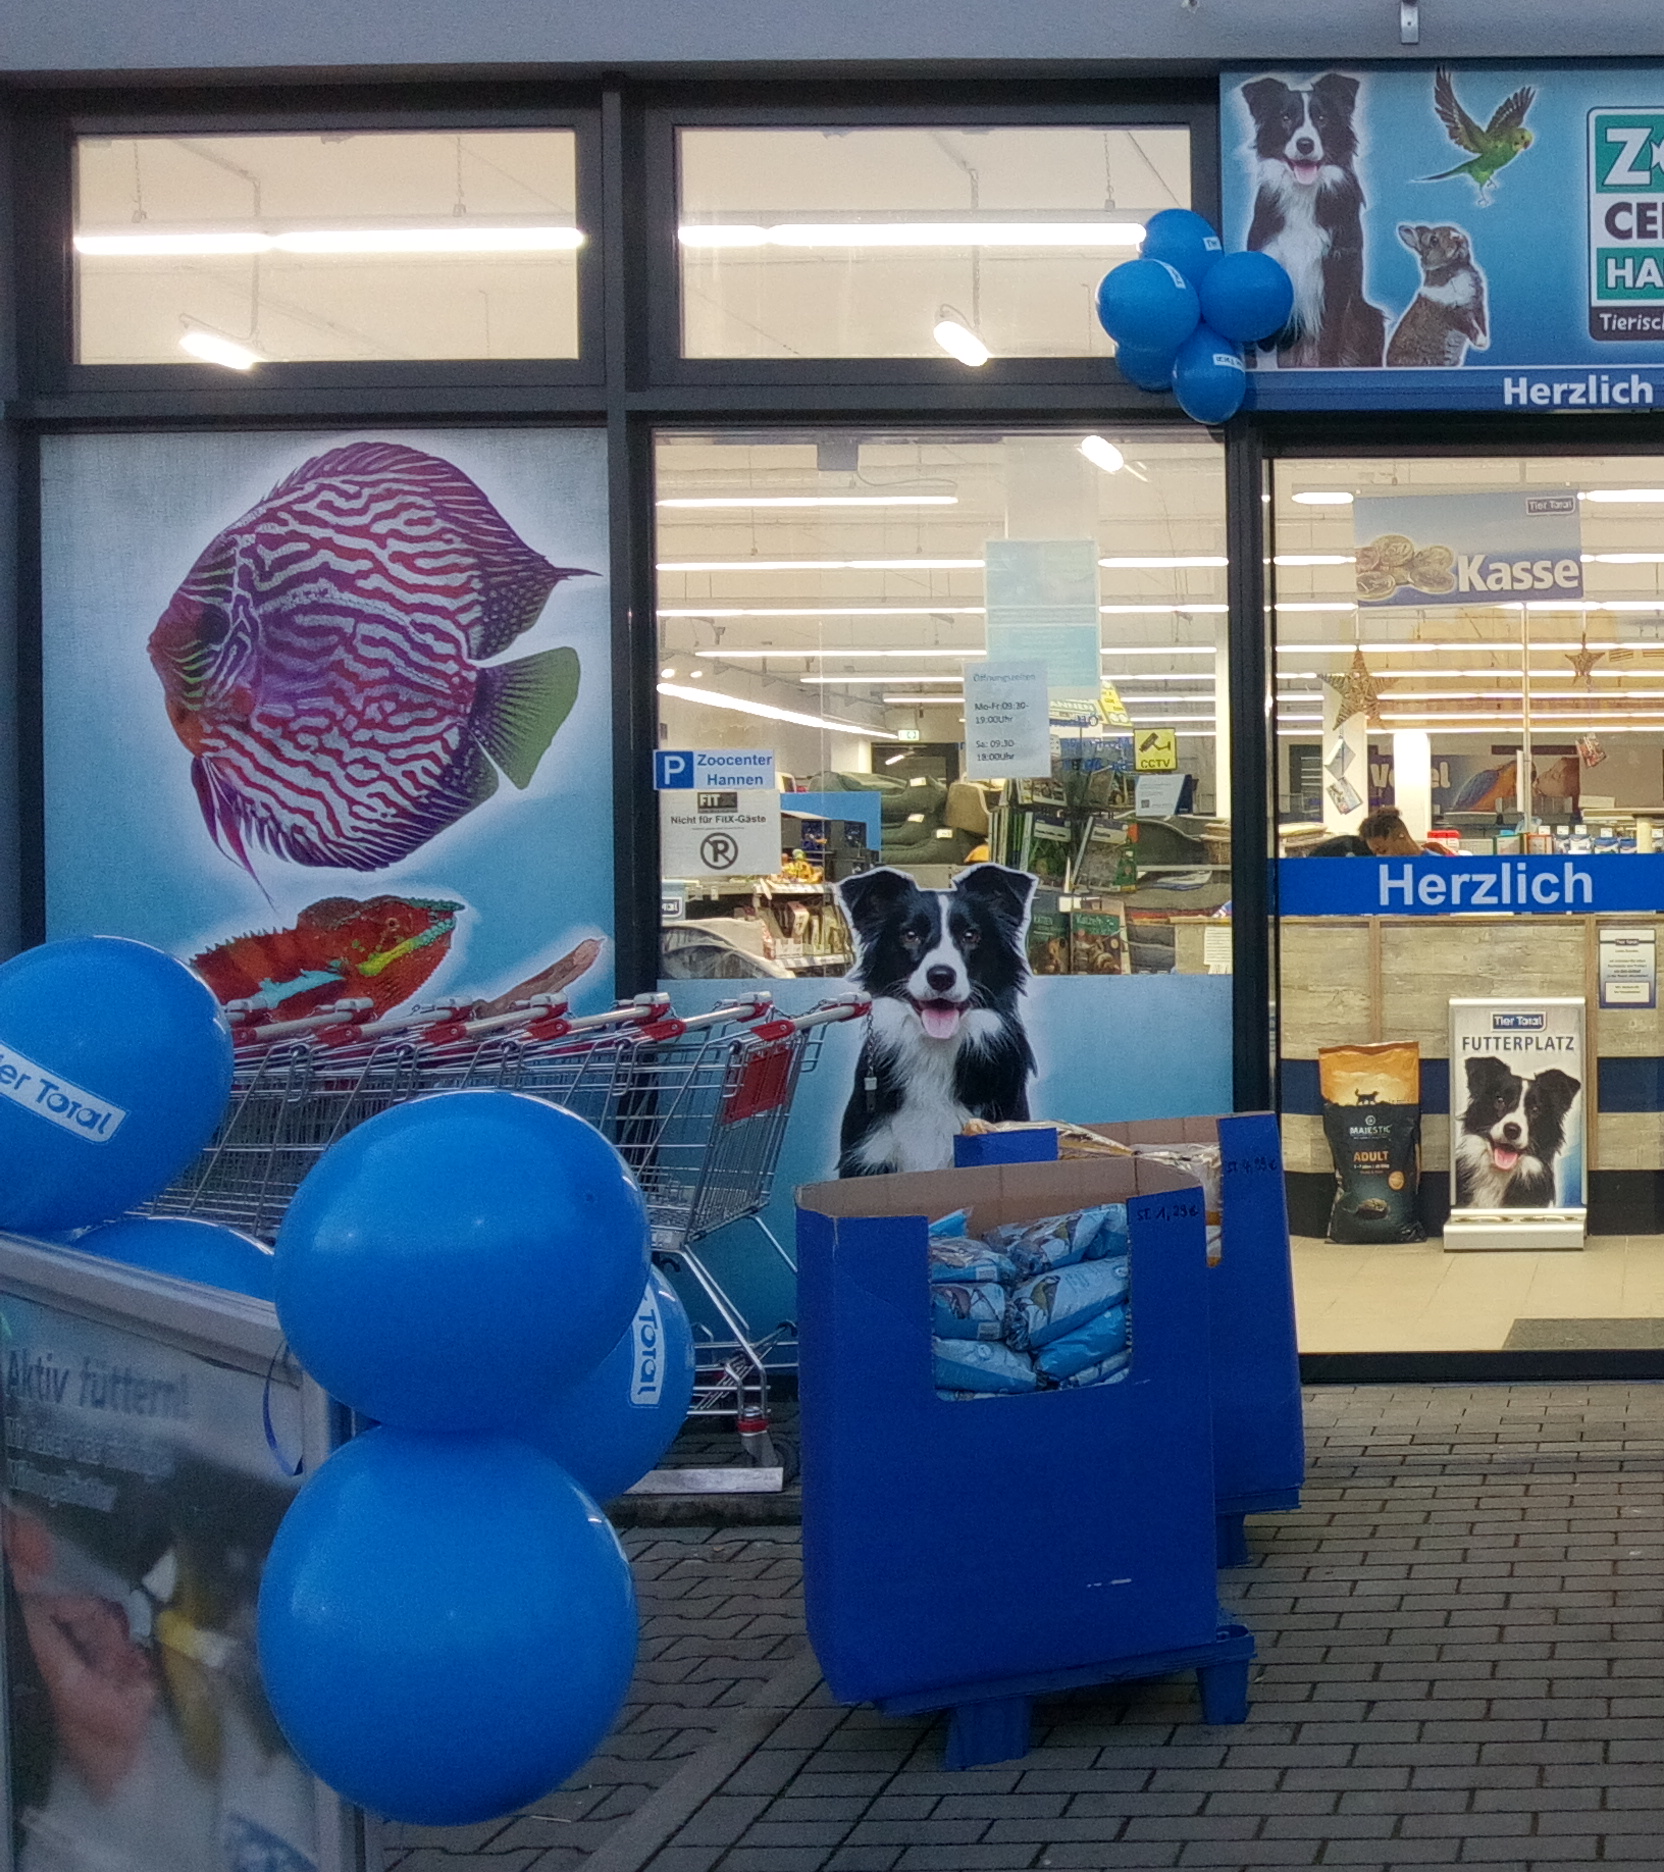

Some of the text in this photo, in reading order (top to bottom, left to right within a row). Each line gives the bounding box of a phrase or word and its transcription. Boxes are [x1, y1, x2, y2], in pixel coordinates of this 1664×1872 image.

[1503, 374, 1653, 405] Herzlich
[1529, 501, 1547, 511] Tier
[1458, 554, 1579, 592] Kasse
[697, 754, 772, 766] Zoocenter
[1140, 759, 1171, 769] CCTV
[707, 774, 763, 785] Hannen
[670, 816, 696, 824] Nicht
[699, 815, 712, 823] für
[1379, 862, 1593, 905] Herzlich
[1494, 1016, 1543, 1026] Tier Total
[1462, 1036, 1574, 1051] FUTTERPLATZ
[35, 1078, 112, 1134] Total
[1349, 1126, 1391, 1135] MAJESTIC
[1353, 1151, 1389, 1162] ADULT
[637, 1309, 658, 1395] Total
[7, 1348, 70, 1404] Aktiv
